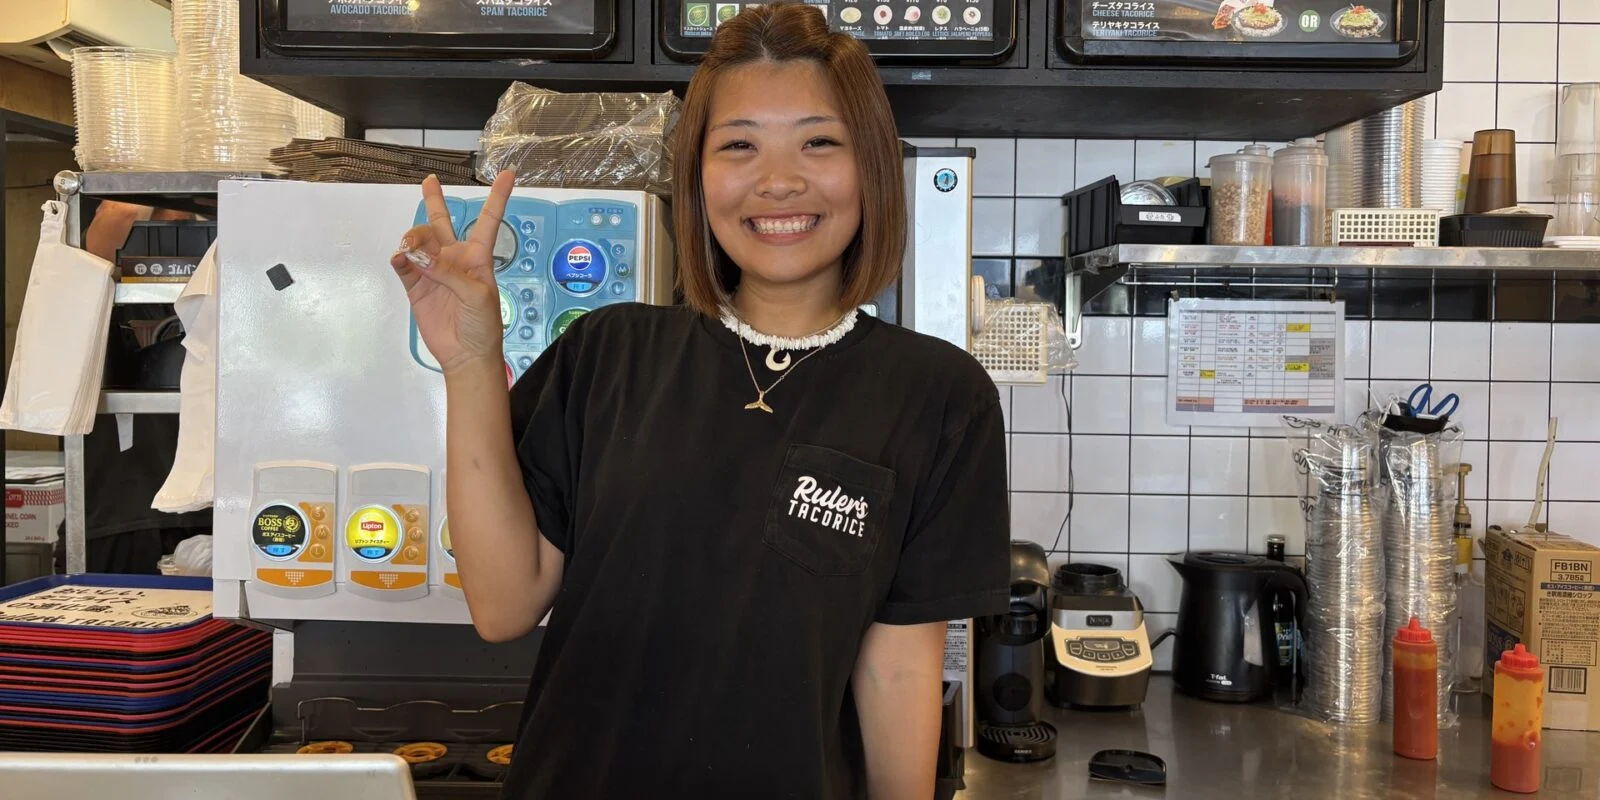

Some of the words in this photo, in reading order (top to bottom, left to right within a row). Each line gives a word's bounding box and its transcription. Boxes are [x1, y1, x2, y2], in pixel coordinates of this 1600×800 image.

[330, 5, 370, 14] AVOCADO
[1092, 2, 1155, 10] チーズタコライス
[480, 6, 504, 16] SPAM
[507, 7, 547, 16] TACORICE
[1122, 10, 1154, 18] TACORICE
[1092, 21, 1160, 29] テリヤキタコライス
[1301, 15, 1318, 28] OR
[525, 223, 532, 234] S
[528, 243, 537, 253] M
[615, 247, 622, 255] S
[793, 476, 869, 519] Ruler's
[258, 517, 282, 527] BOSS
[788, 499, 865, 537] TACORICE
[362, 522, 382, 530] Lipton
[1554, 562, 1588, 571] FB1BN
[29, 595, 138, 604] タコライス
